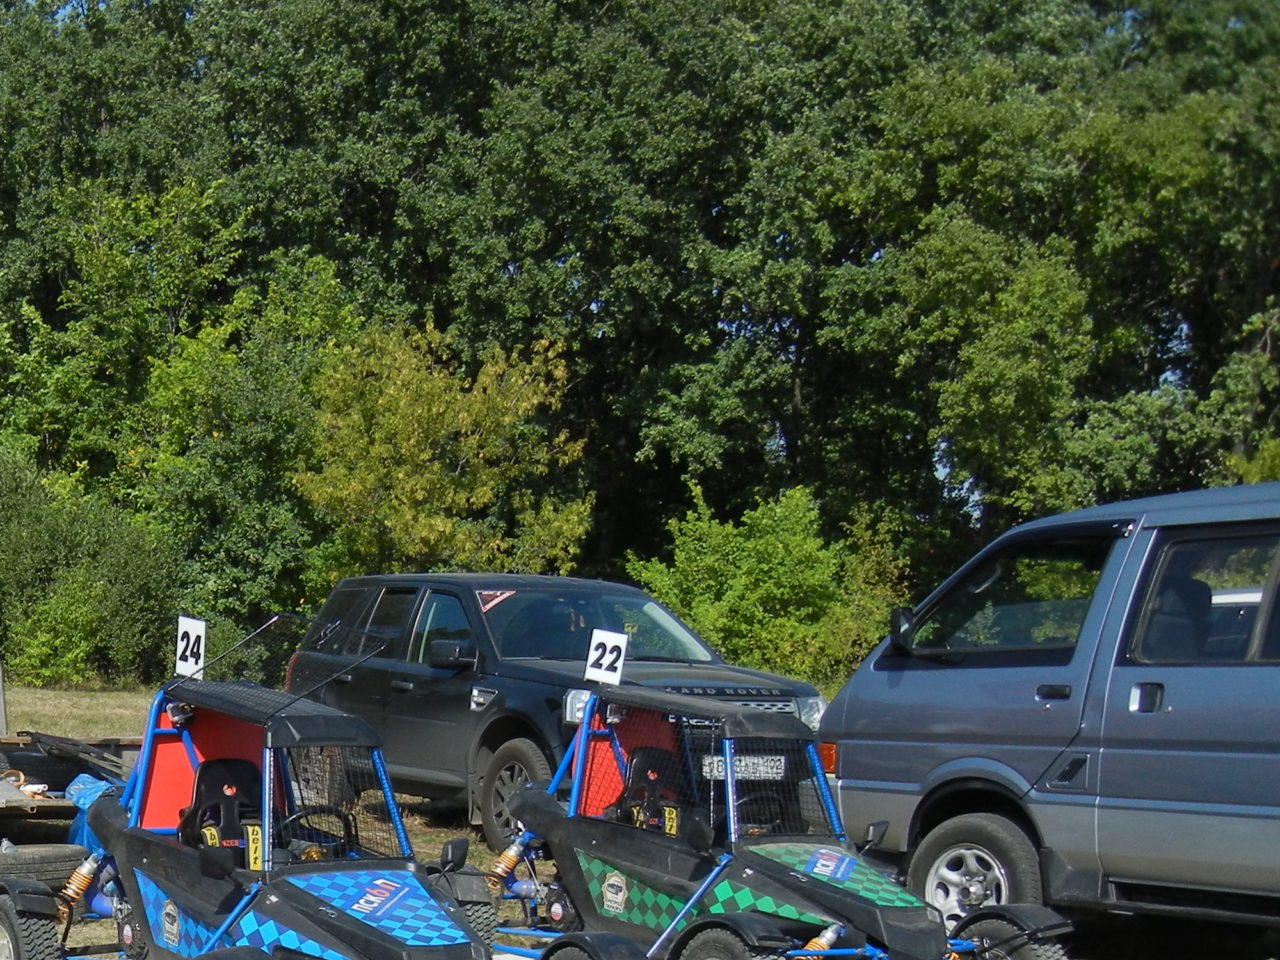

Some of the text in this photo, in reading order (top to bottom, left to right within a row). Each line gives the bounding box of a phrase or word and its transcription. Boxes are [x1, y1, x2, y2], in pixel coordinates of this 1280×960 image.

[179, 630, 201, 665] 24
[589, 642, 622, 673] 22
[666, 687, 782, 696] LAND ROVER
[251, 828, 259, 865] belt
